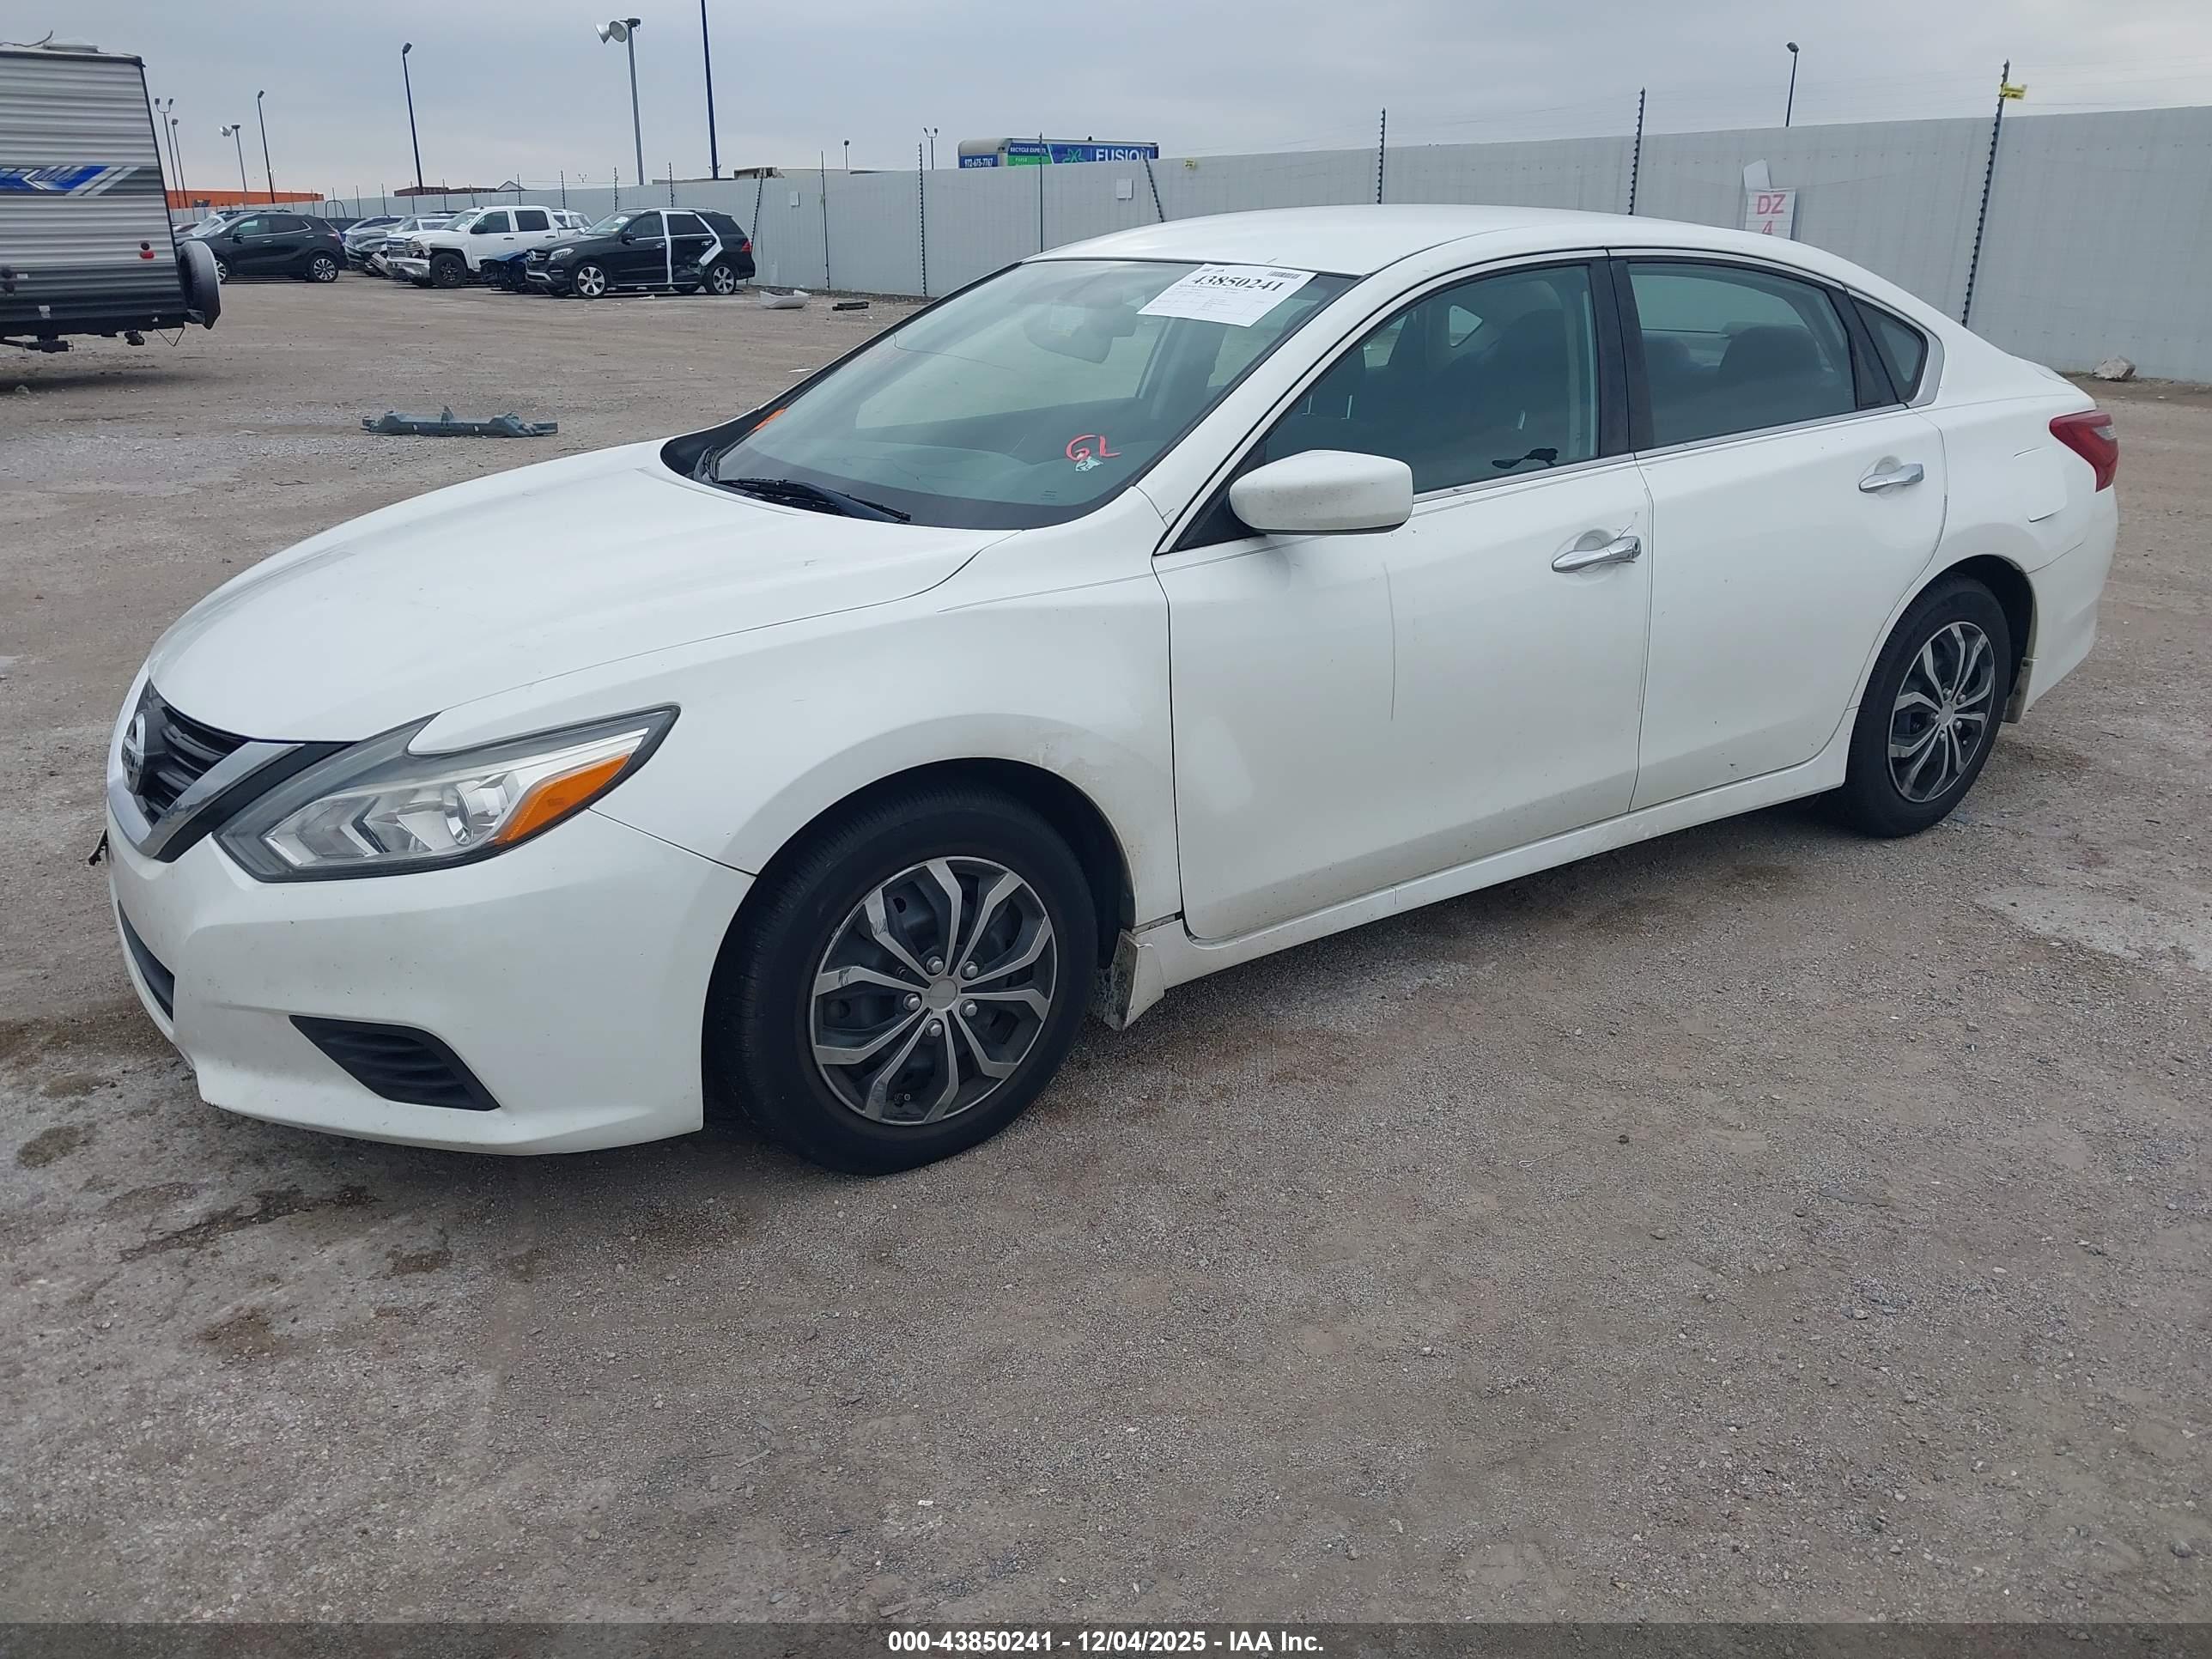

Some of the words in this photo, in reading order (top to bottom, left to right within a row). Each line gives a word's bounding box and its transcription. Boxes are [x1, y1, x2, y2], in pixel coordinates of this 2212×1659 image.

[1756, 193, 1786, 215] DZ
[1761, 220, 1773, 235] 4
[1191, 274, 1285, 292] 43850241
